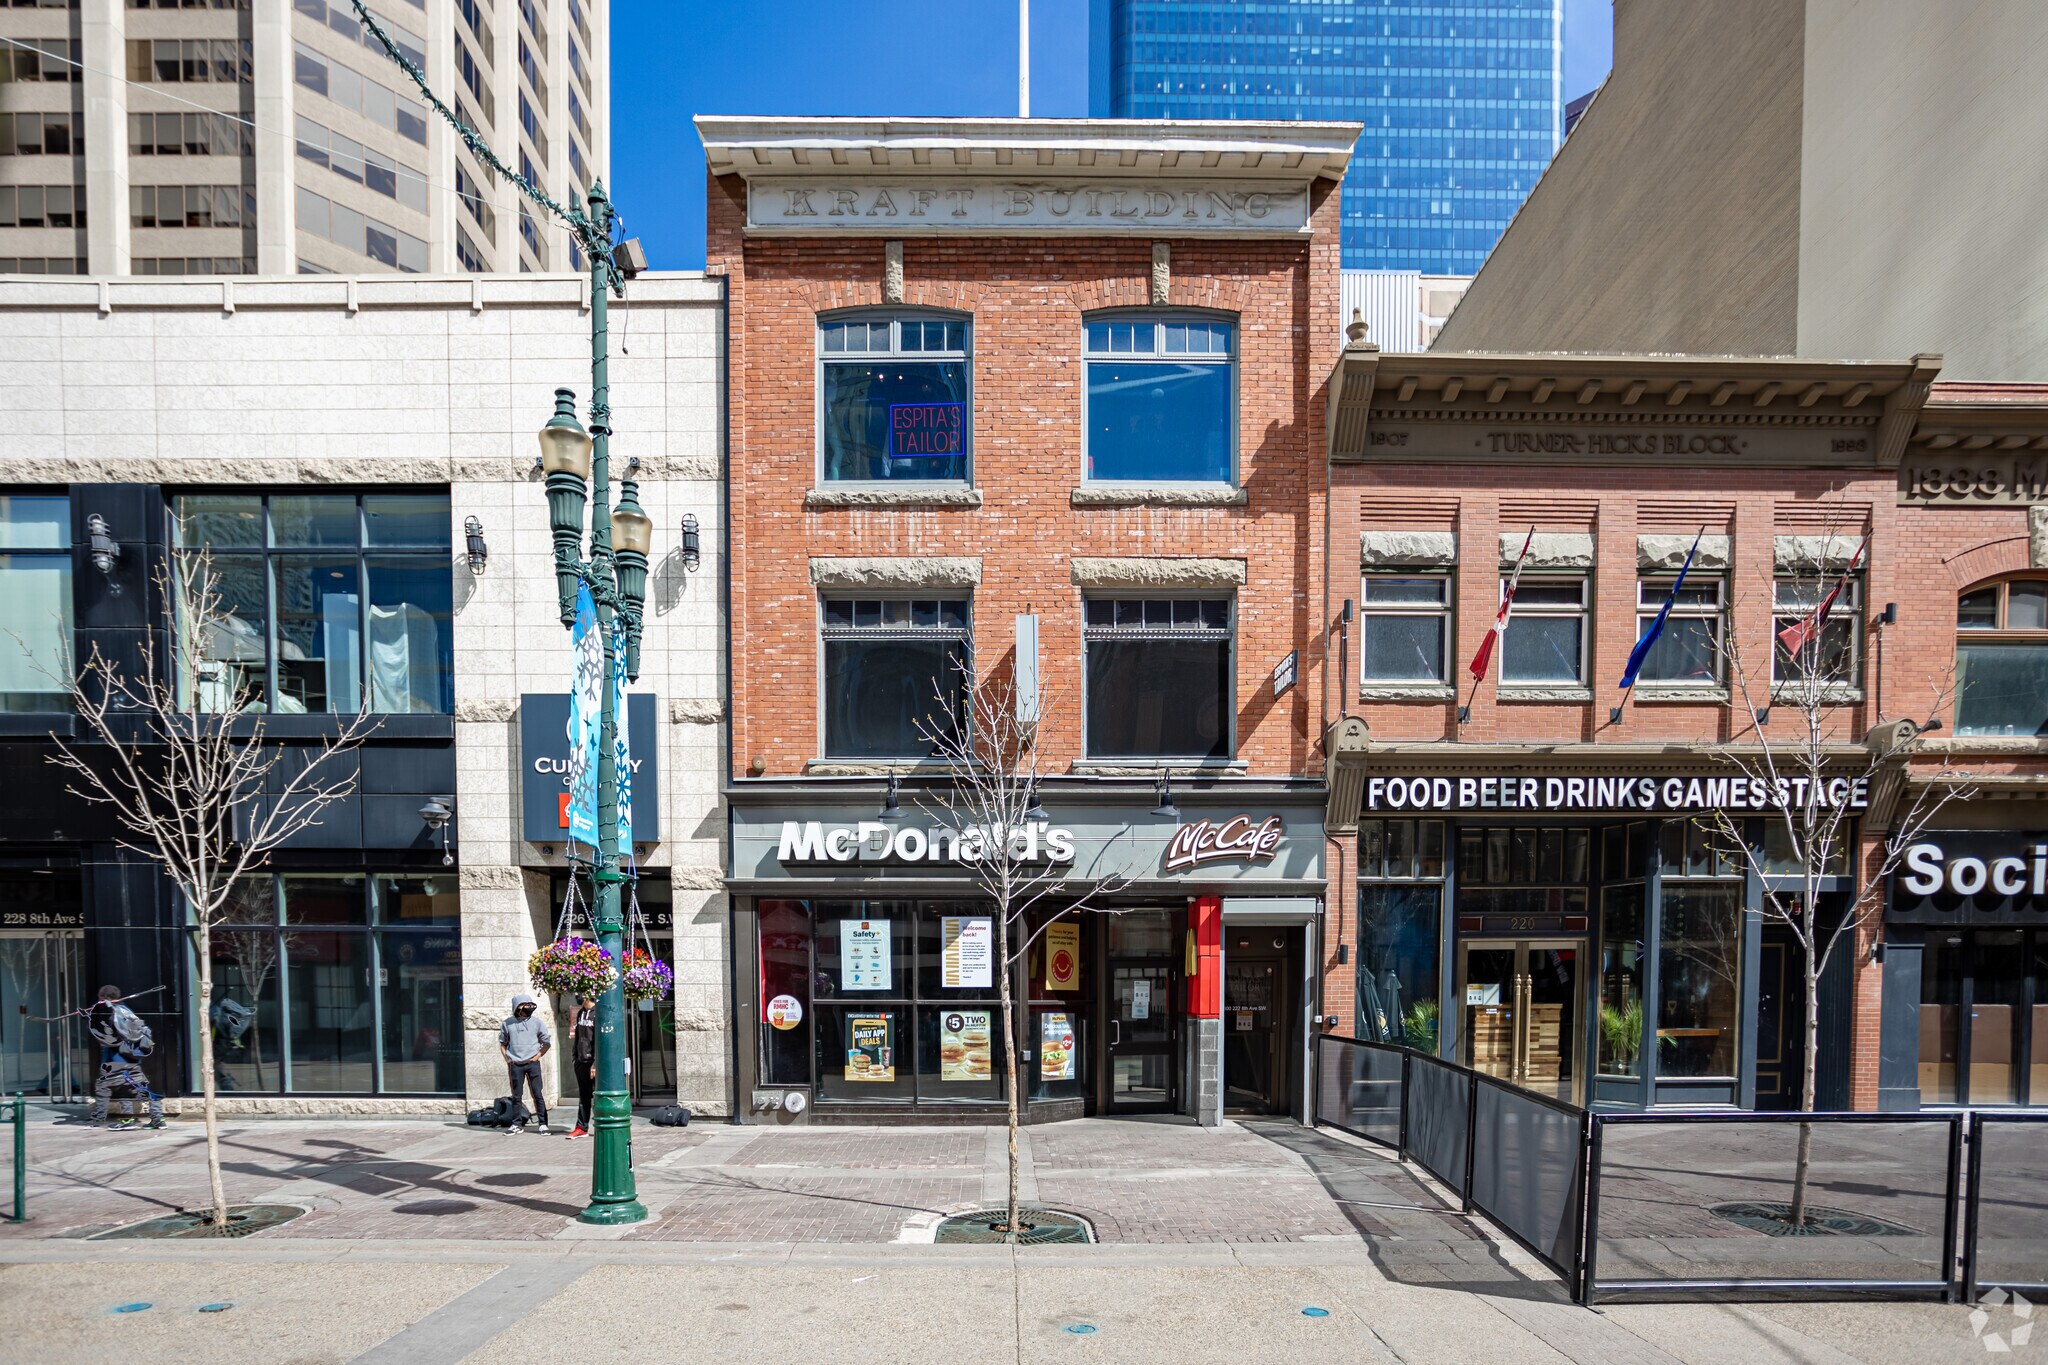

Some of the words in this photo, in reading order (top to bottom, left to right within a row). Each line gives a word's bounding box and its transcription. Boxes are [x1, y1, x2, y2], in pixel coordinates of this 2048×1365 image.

[783, 188, 974, 217] KRAFT
[1003, 189, 1273, 219] BUILDING
[893, 406, 961, 429] ESPITA'S
[895, 431, 960, 453] TAILOR
[1370, 432, 1409, 446] 1907
[1661, 433, 1742, 456] BLOCK
[1909, 465, 2006, 494] 1888
[2014, 459, 2048, 496] M
[1368, 777, 1453, 807] FOOD
[1459, 777, 1539, 807] BEER
[1545, 777, 1656, 808] DRINKS
[1662, 777, 1768, 808] GAMES
[1771, 777, 1869, 808] STAGE
[776, 820, 1075, 862] McDonald's
[1168, 817, 1280, 867] McCafé
[1904, 843, 2047, 896] Soci
[4, 913, 26, 924] 228
[29, 912, 51, 924] 8th
[53, 913, 76, 924] Ave
[1511, 917, 1535, 930] 220
[965, 1016, 986, 1024] TWO
[855, 1029, 872, 1039] DAILY
[872, 1029, 885, 1037] APP
[860, 1037, 880, 1045] DEALS
